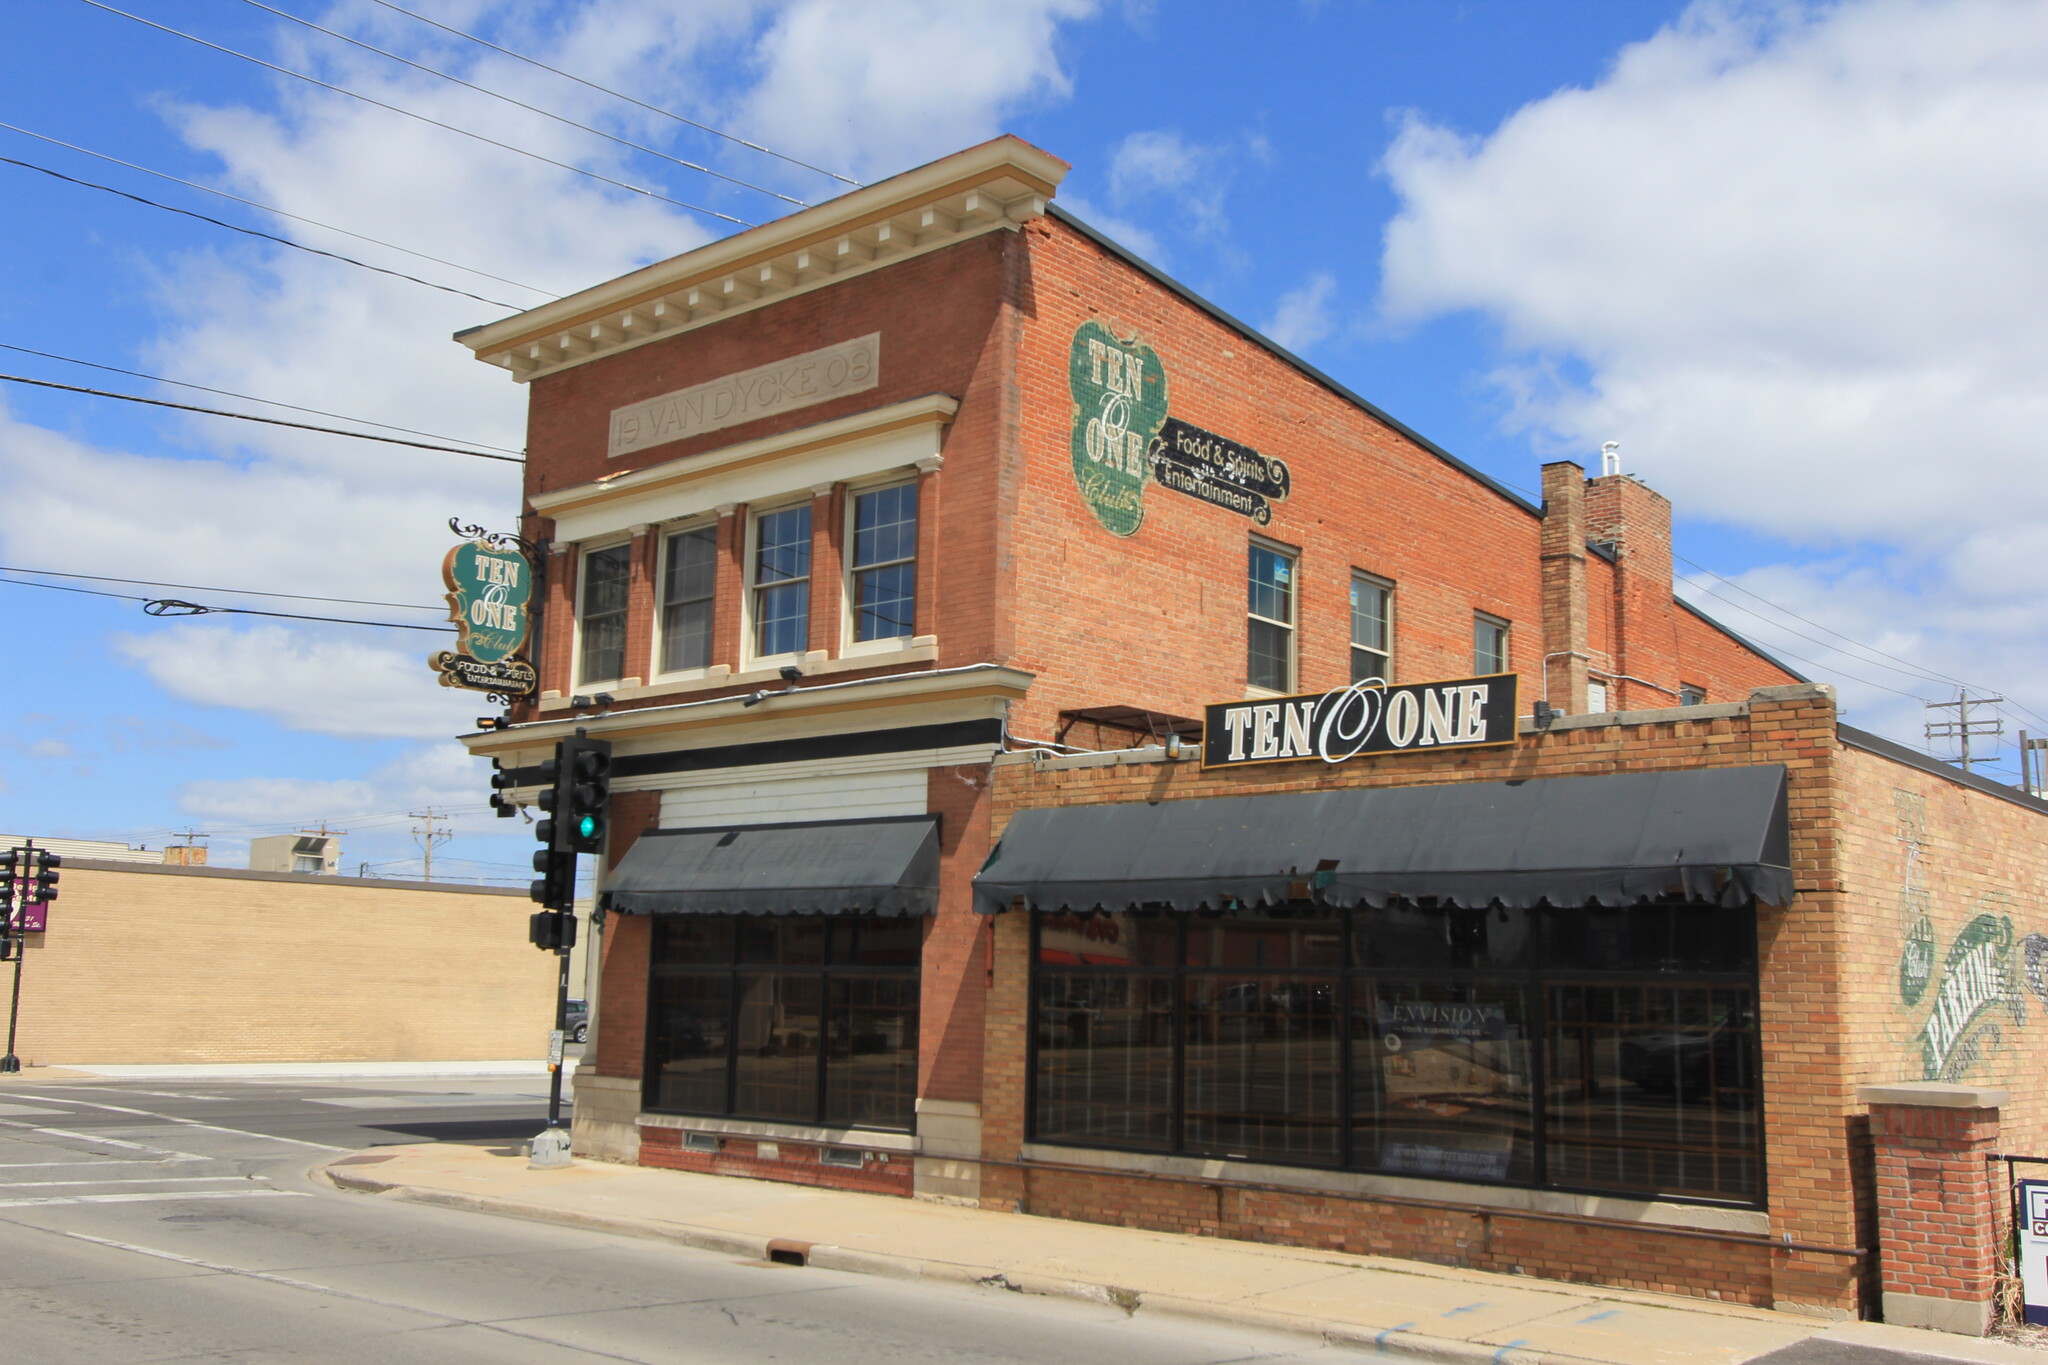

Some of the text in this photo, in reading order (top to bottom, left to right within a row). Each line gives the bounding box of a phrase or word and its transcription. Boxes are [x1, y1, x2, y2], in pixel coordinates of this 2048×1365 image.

[1088, 337, 1144, 401] TEN
[616, 414, 641, 447] 19
[650, 395, 704, 437] VAN
[713, 361, 818, 421] DYCKE
[1085, 417, 1143, 479] ONE
[1176, 430, 1265, 483] Food & Spirits
[1082, 466, 1132, 510] Club
[1164, 464, 1253, 512] Entertainment
[475, 554, 520, 588] TEN
[471, 599, 517, 632] ONE
[481, 629, 515, 651] Club
[1225, 702, 1315, 761] TEN
[1386, 684, 1489, 748] ONE
[1392, 1005, 1488, 1025] ENVISION
[1401, 1025, 1423, 1034] YOUR
[1424, 1026, 1460, 1036] BUSINESS
